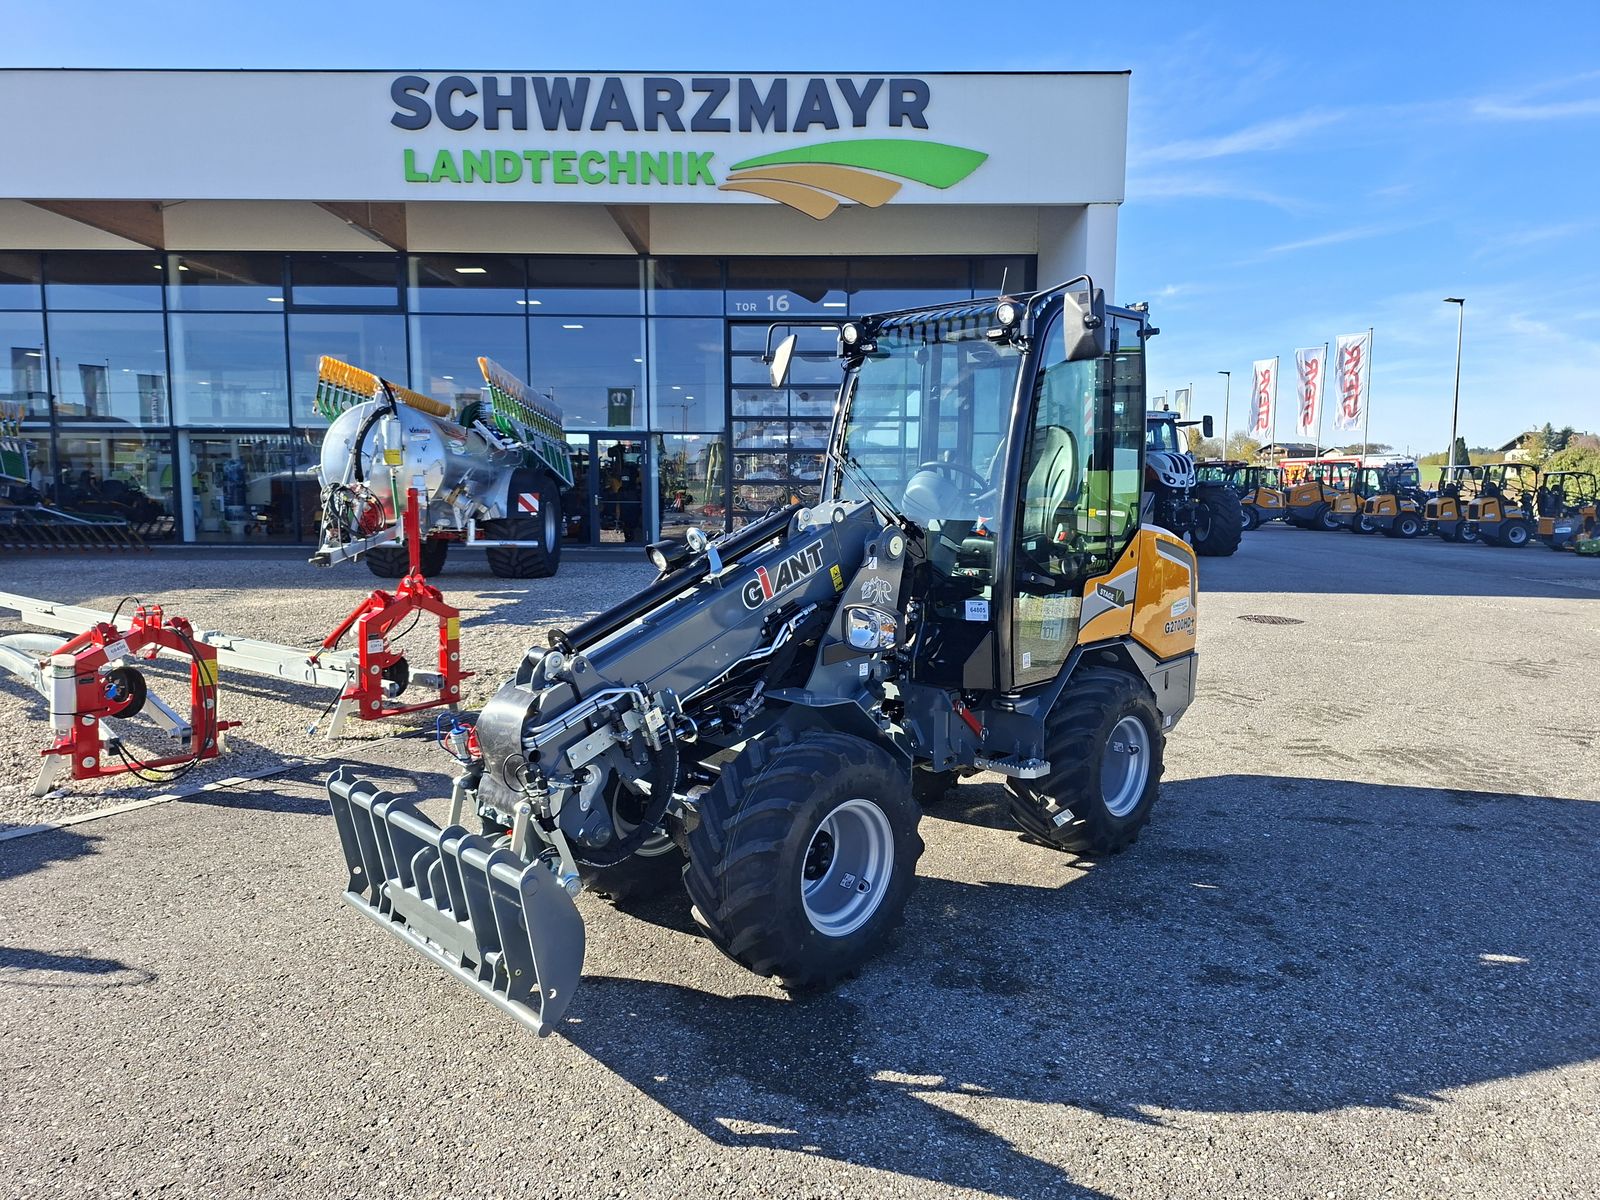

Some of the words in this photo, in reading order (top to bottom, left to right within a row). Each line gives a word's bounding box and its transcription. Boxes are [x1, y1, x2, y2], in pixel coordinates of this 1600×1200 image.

[390, 76, 929, 133] SCHWARZMAYR
[404, 149, 716, 186] LANDTECHNIK
[736, 303, 757, 311] TOR
[767, 295, 790, 312] 16
[742, 539, 824, 610] GIANT
[1100, 588, 1114, 601] STAGE
[1116, 590, 1123, 602] V
